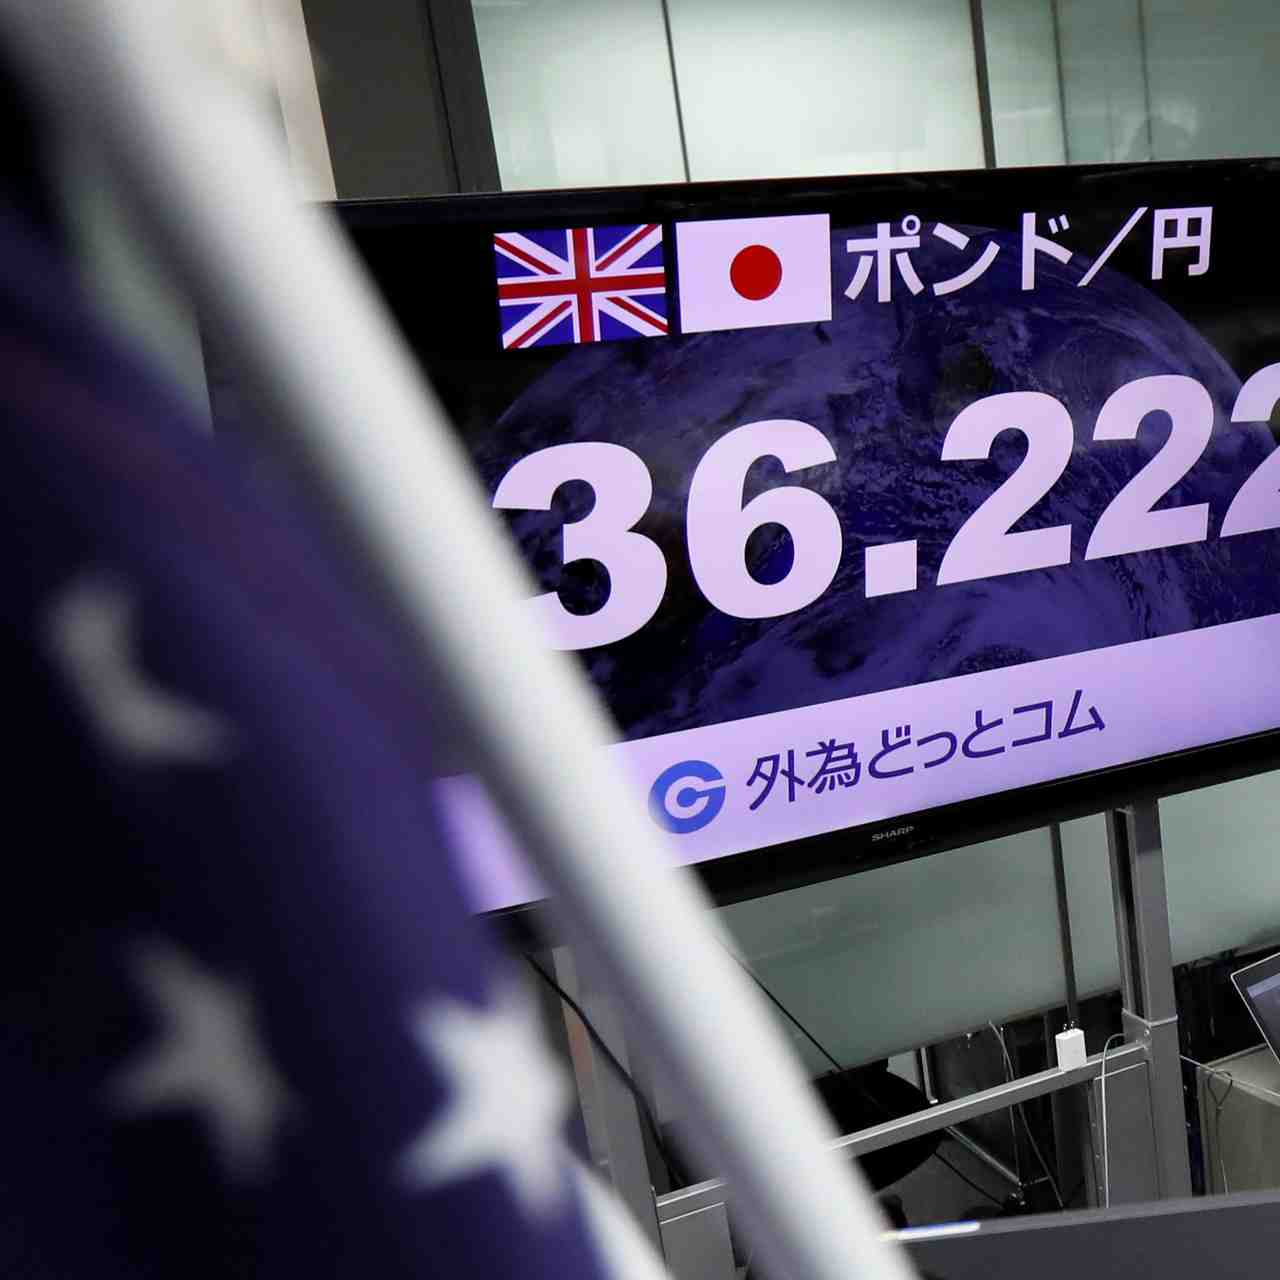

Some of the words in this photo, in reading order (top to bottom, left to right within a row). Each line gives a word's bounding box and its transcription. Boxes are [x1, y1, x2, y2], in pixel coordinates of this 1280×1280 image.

[746, 688, 1107, 813] 外為どっとコム
